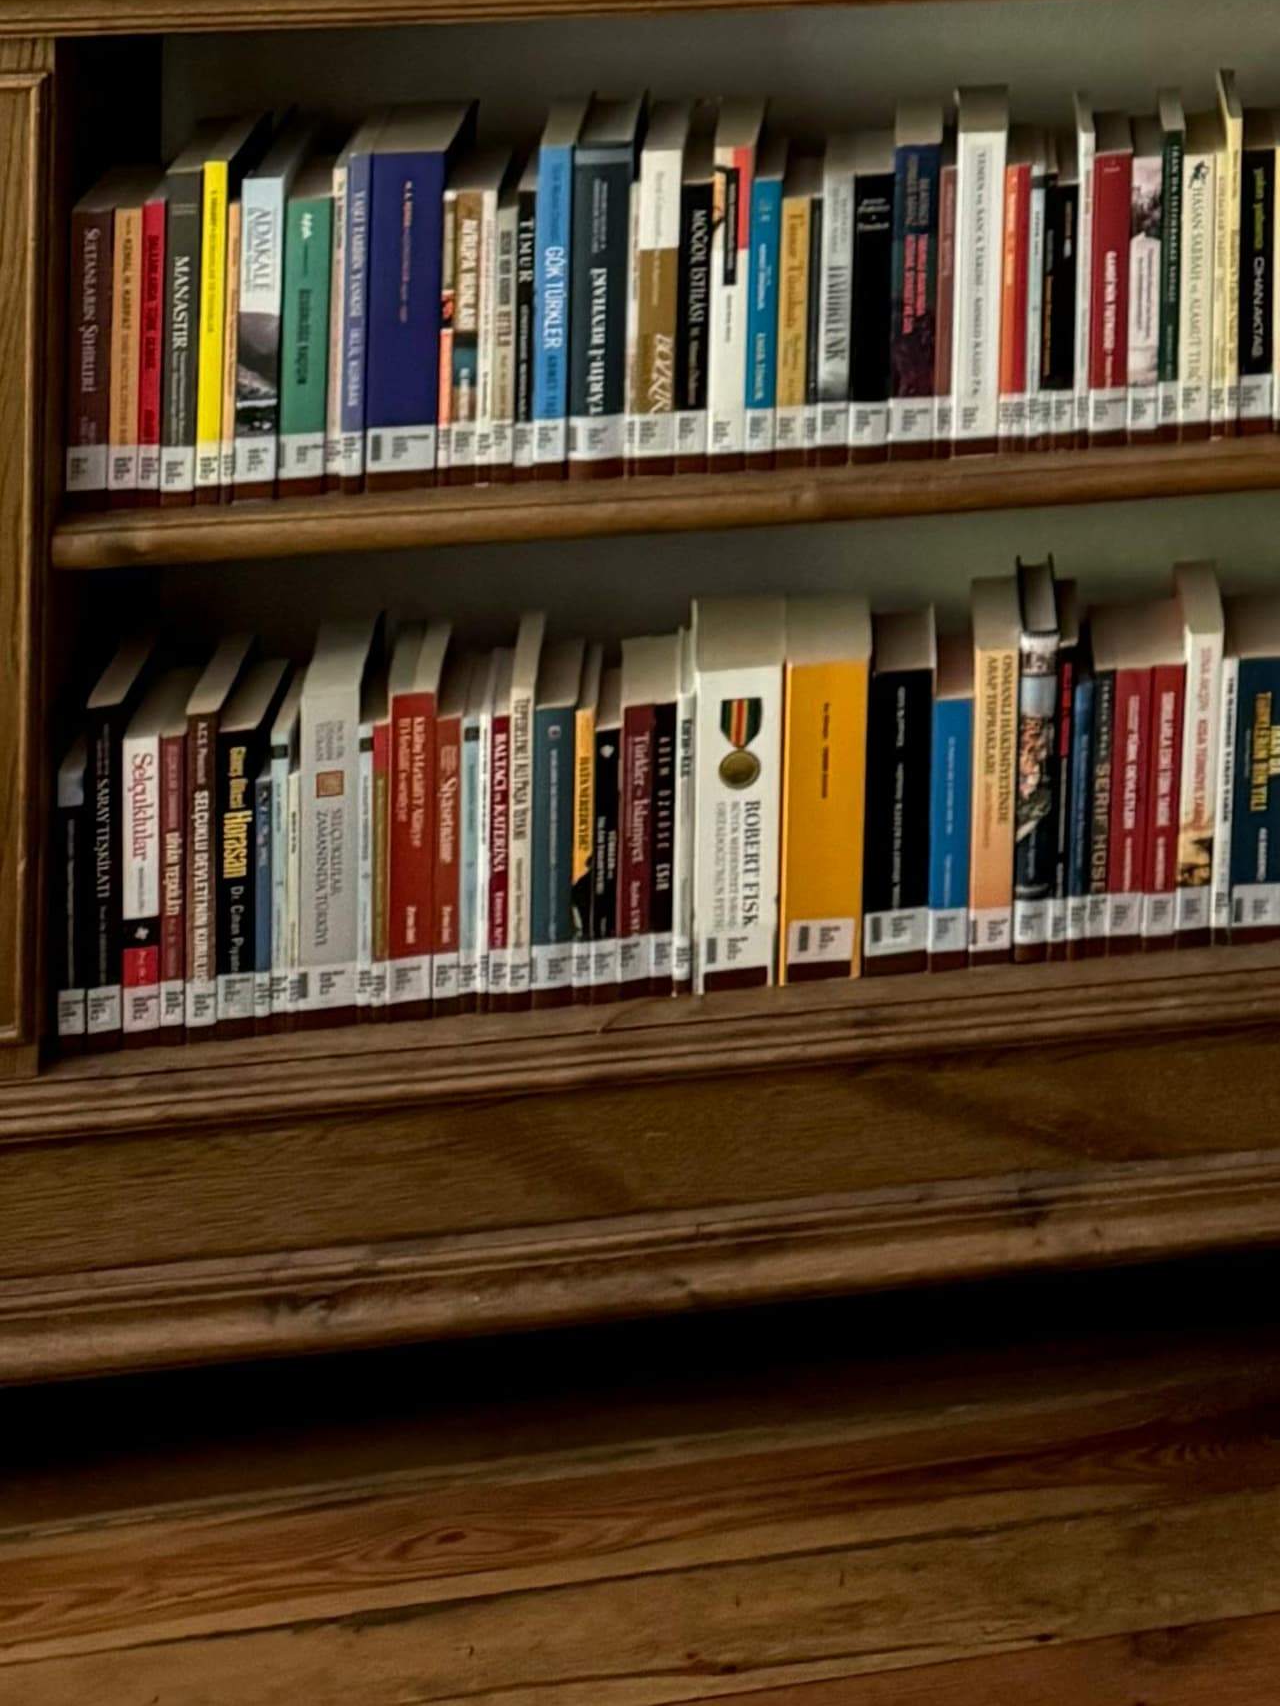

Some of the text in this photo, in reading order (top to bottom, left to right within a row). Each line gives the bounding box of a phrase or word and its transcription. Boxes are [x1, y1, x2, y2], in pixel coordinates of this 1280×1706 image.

[172, 255, 191, 350] MANASTIR
[130, 752, 154, 861] Selçuklular
[741, 799, 763, 928] ROBERT FISK
